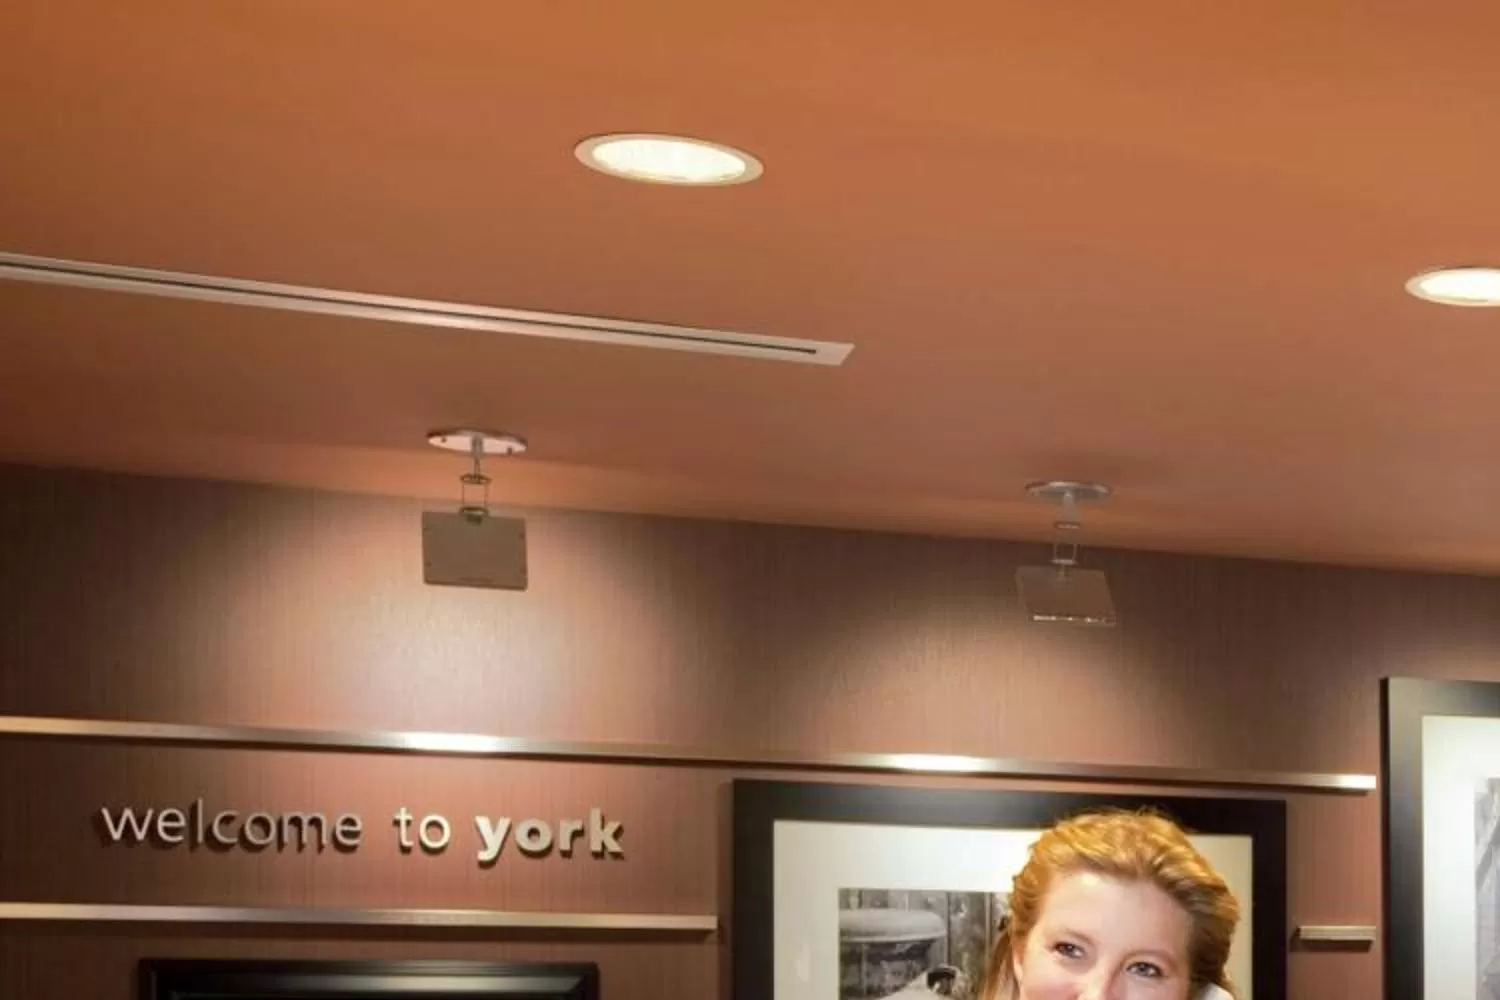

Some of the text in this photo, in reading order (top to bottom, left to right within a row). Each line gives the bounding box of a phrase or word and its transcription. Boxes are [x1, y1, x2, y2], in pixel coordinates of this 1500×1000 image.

[99, 798, 624, 864] welcome to york
